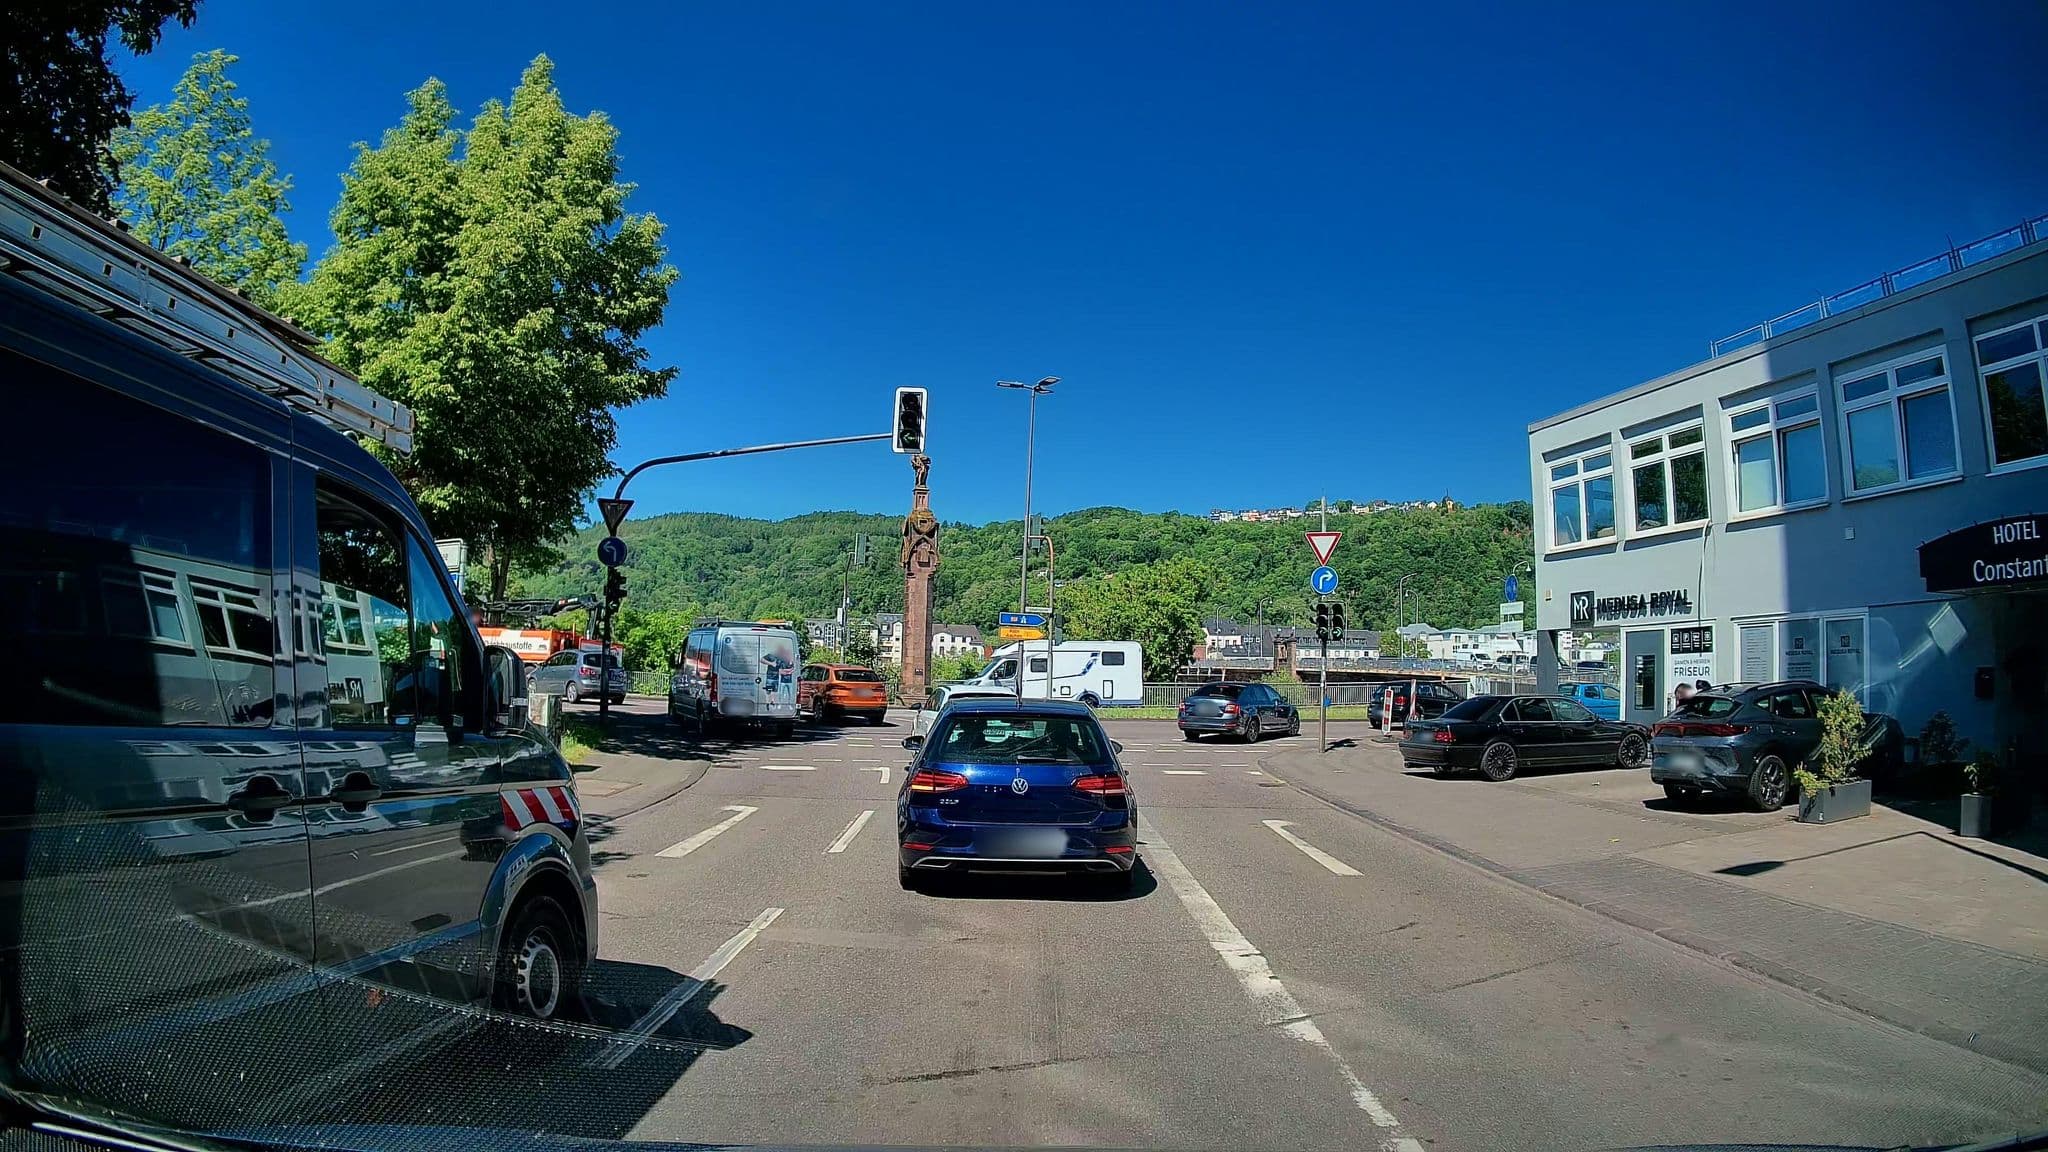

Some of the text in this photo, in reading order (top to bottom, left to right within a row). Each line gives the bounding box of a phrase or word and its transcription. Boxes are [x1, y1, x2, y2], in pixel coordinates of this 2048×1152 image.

[1993, 520, 2041, 545] HOTEL
[1596, 588, 1690, 615] MEDUSA ROYAL
[1674, 666, 1710, 677] FRISEUR
